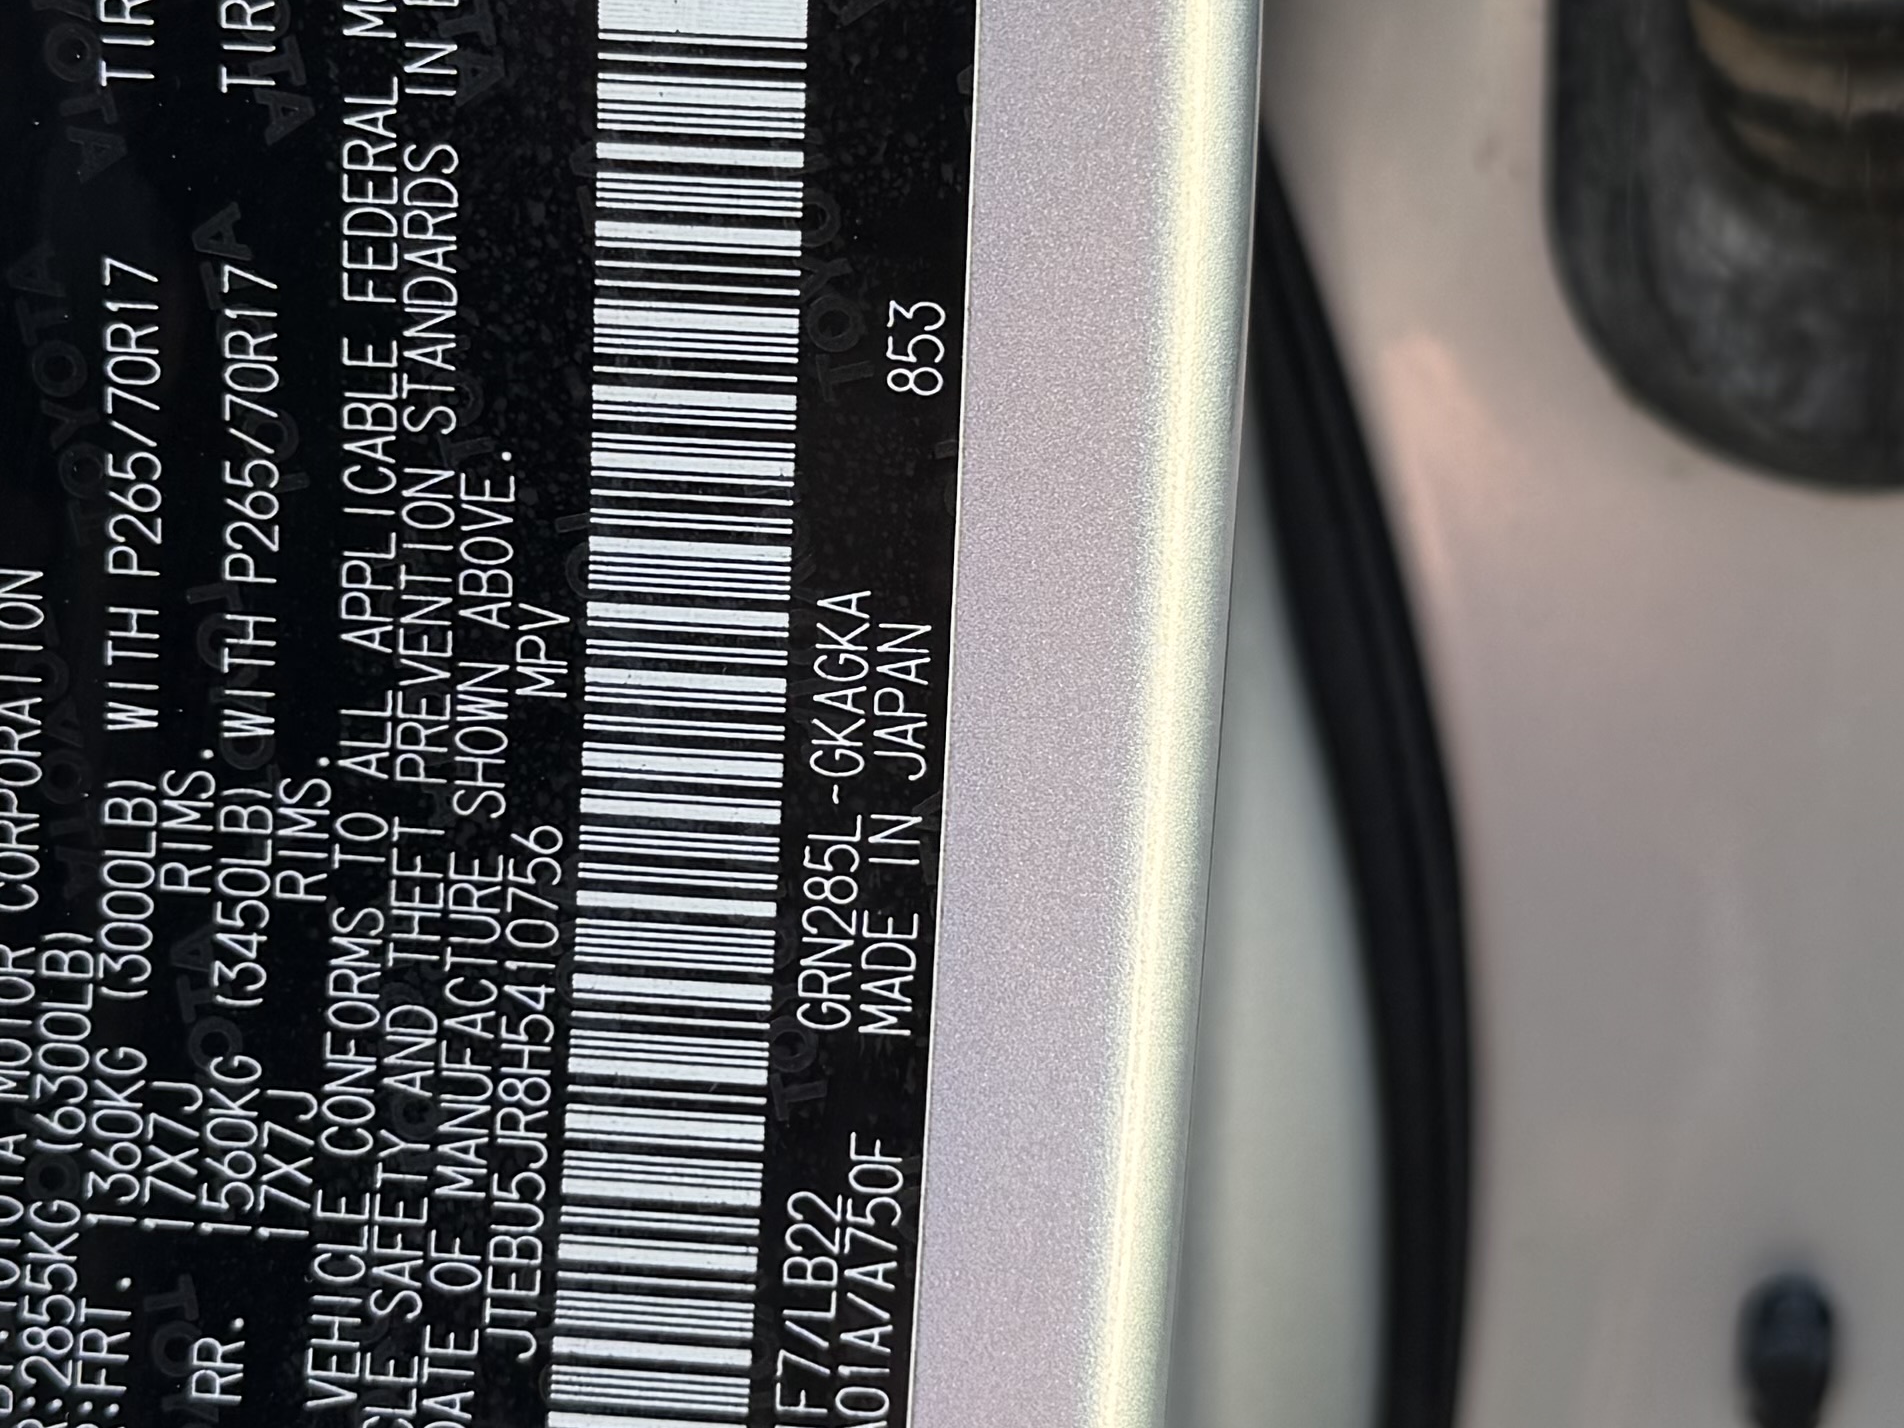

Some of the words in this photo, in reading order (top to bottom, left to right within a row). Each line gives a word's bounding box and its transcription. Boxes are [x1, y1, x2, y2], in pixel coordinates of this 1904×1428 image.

[403, 41, 458, 97] IN
[341, 75, 399, 304] FEDERAL
[401, 143, 459, 435] STANDARDS
[885, 299, 946, 397] 853
[103, 257, 162, 577] P265/70R17
[222, 264, 280, 584] P265/70R17
[340, 337, 399, 654] APPLICABLE
[458, 451, 516, 630] ABOVE.
[106, 606, 160, 731] WITH
[221, 613, 277, 738] WITH
[395, 467, 456, 784] PREVENTION
[514, 602, 571, 699] MPV
[872, 623, 933, 782] JAPAN
[337, 689, 393, 780] ALL
[452, 661, 511, 819] SHOWN
[97, 780, 158, 998] (3000LB)
[158, 749, 216, 894] RIMS.
[212, 787, 274, 1007] (3450LB)
[274, 756, 332, 902] RIMS.
[332, 812, 389, 870] TO
[387, 816, 446, 968] THEFT
[867, 813, 923, 866] IN
[33, 932, 95, 1151] (6300LB)
[319, 906, 385, 1156] CONFORMS
[381, 1004, 438, 1098] AND
[434, 851, 504, 1199] MANUFACTURE
[857, 909, 919, 1037] MADE
[85, 1046, 148, 1225] 1360KG
[142, 1080, 203, 1229] 17X7J
[199, 1055, 263, 1233] 1560KG
[257, 1089, 319, 1238] 17X7J
[484, 825, 564, 1361] JTEBU5JR8H5410756
[305, 1188, 371, 1408] VEHICLE
[368, 1128, 431, 1320] SAFETY
[428, 1229, 483, 1292] OF
[189, 1317, 246, 1402] RR.
